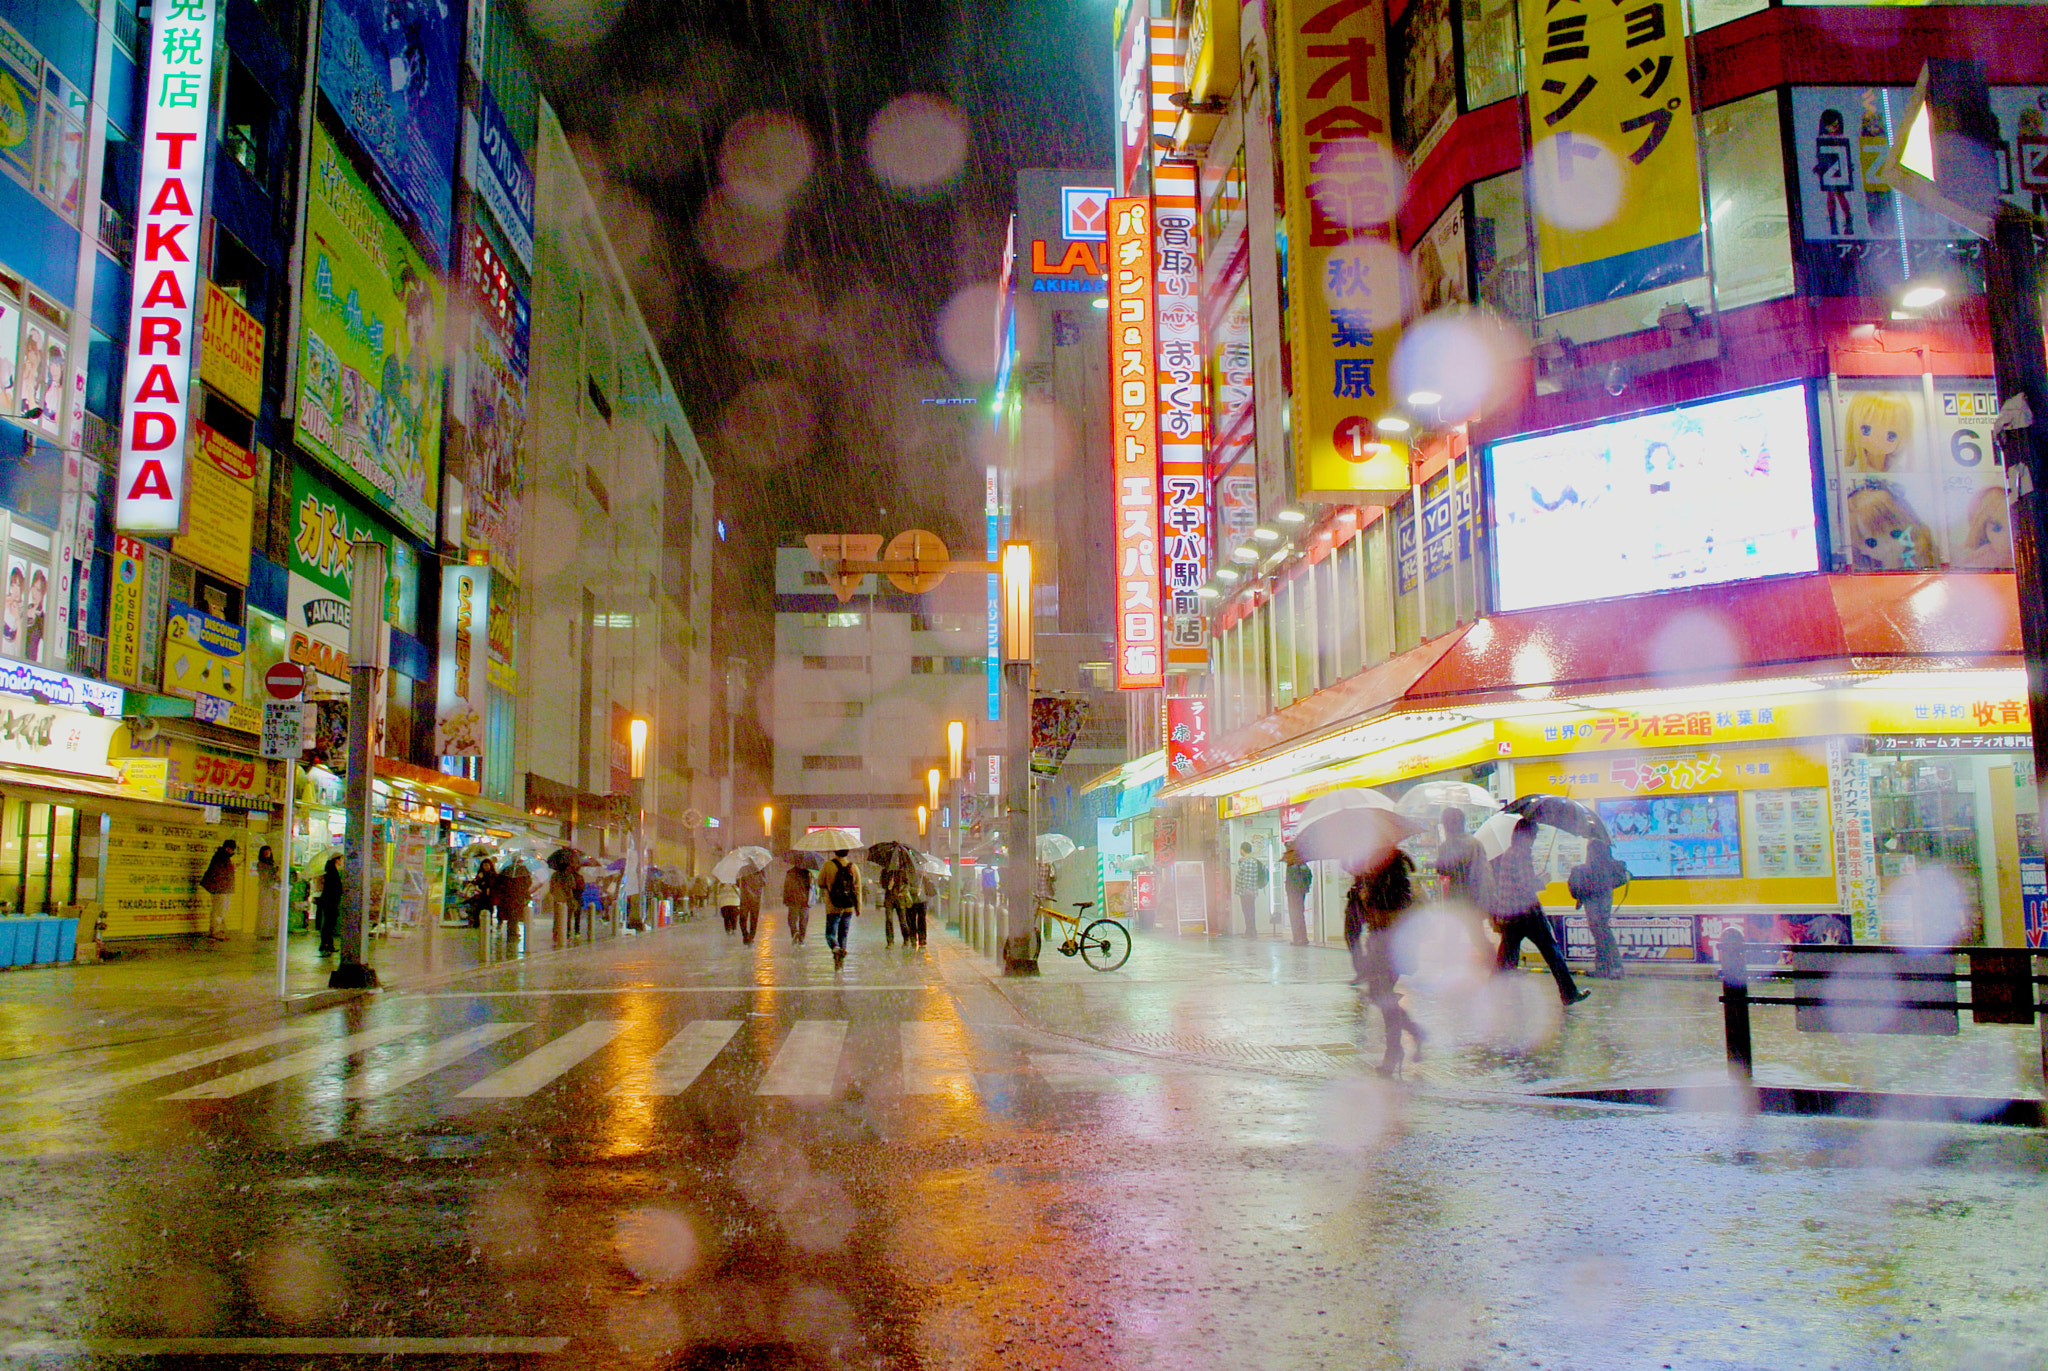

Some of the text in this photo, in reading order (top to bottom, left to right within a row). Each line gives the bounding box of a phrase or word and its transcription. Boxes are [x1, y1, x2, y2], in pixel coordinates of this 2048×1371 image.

[1541, 0, 1601, 183] ミント
[1620, 0, 1682, 166] ョップ
[1160, 217, 1194, 298] 買取り
[127, 132, 198, 500] TAKARADA
[203, 324, 260, 380] DISCOUNT
[1116, 204, 1147, 463] パチンコ&スロット
[1327, 256, 1376, 399] 秋葉原
[120, 538, 140, 554] 2F
[1171, 480, 1201, 644] アキバ駅前店
[171, 619, 185, 639] 2F
[200, 629, 242, 653] COMPUTERS
[204, 617, 240, 640] DISCOUNT
[455, 574, 474, 702] GAMERS
[1544, 708, 1775, 745] 世界の ラジオ会館 秋葉原
[1611, 753, 1722, 791] ラジカメ
